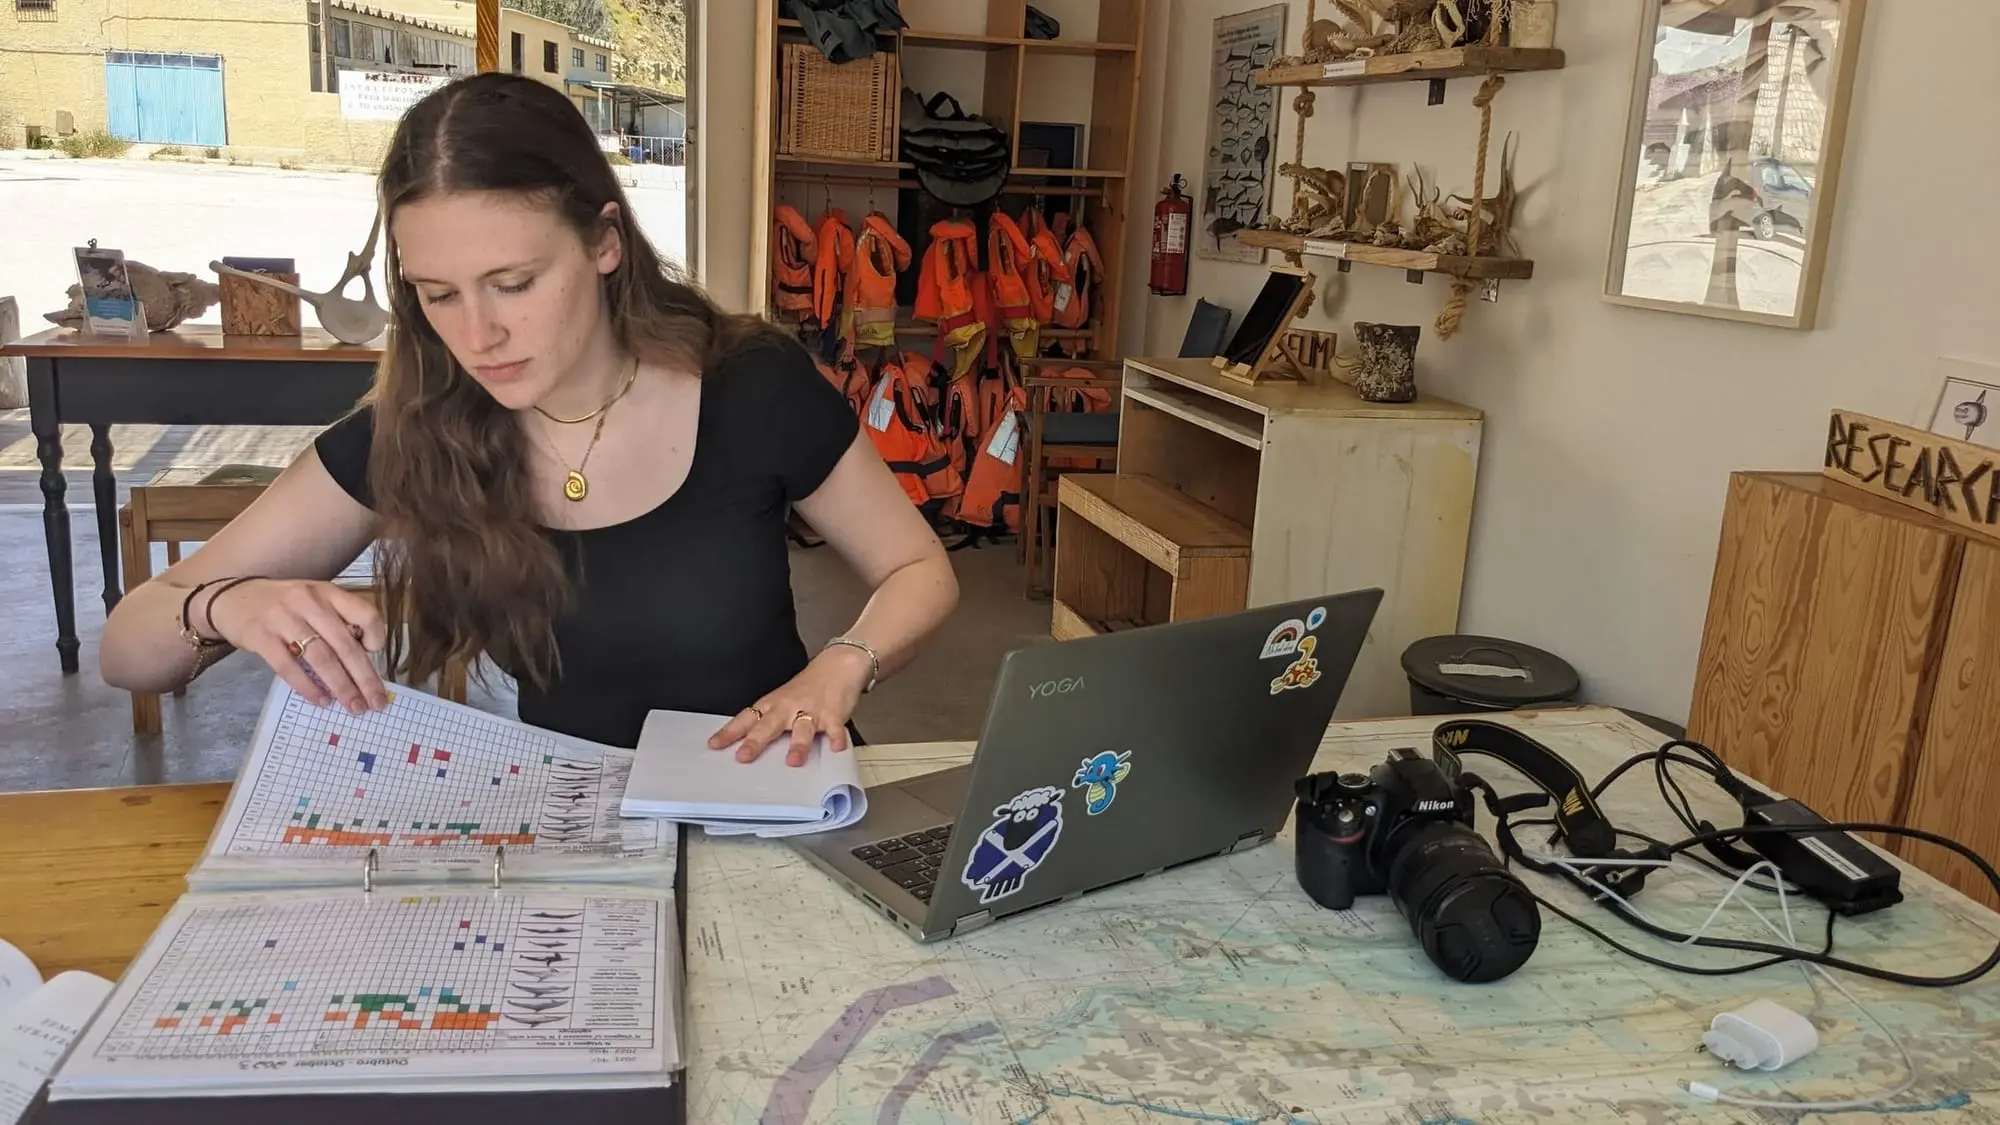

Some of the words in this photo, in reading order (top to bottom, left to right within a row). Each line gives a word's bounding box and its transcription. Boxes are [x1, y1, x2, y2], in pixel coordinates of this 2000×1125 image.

[1268, 331, 1330, 370] SEUM
[1029, 676, 1085, 700] YOGA
[1418, 800, 1455, 811] Nikon
[294, 1060, 345, 1068] October
[356, 1059, 409, 1067] Outubro
